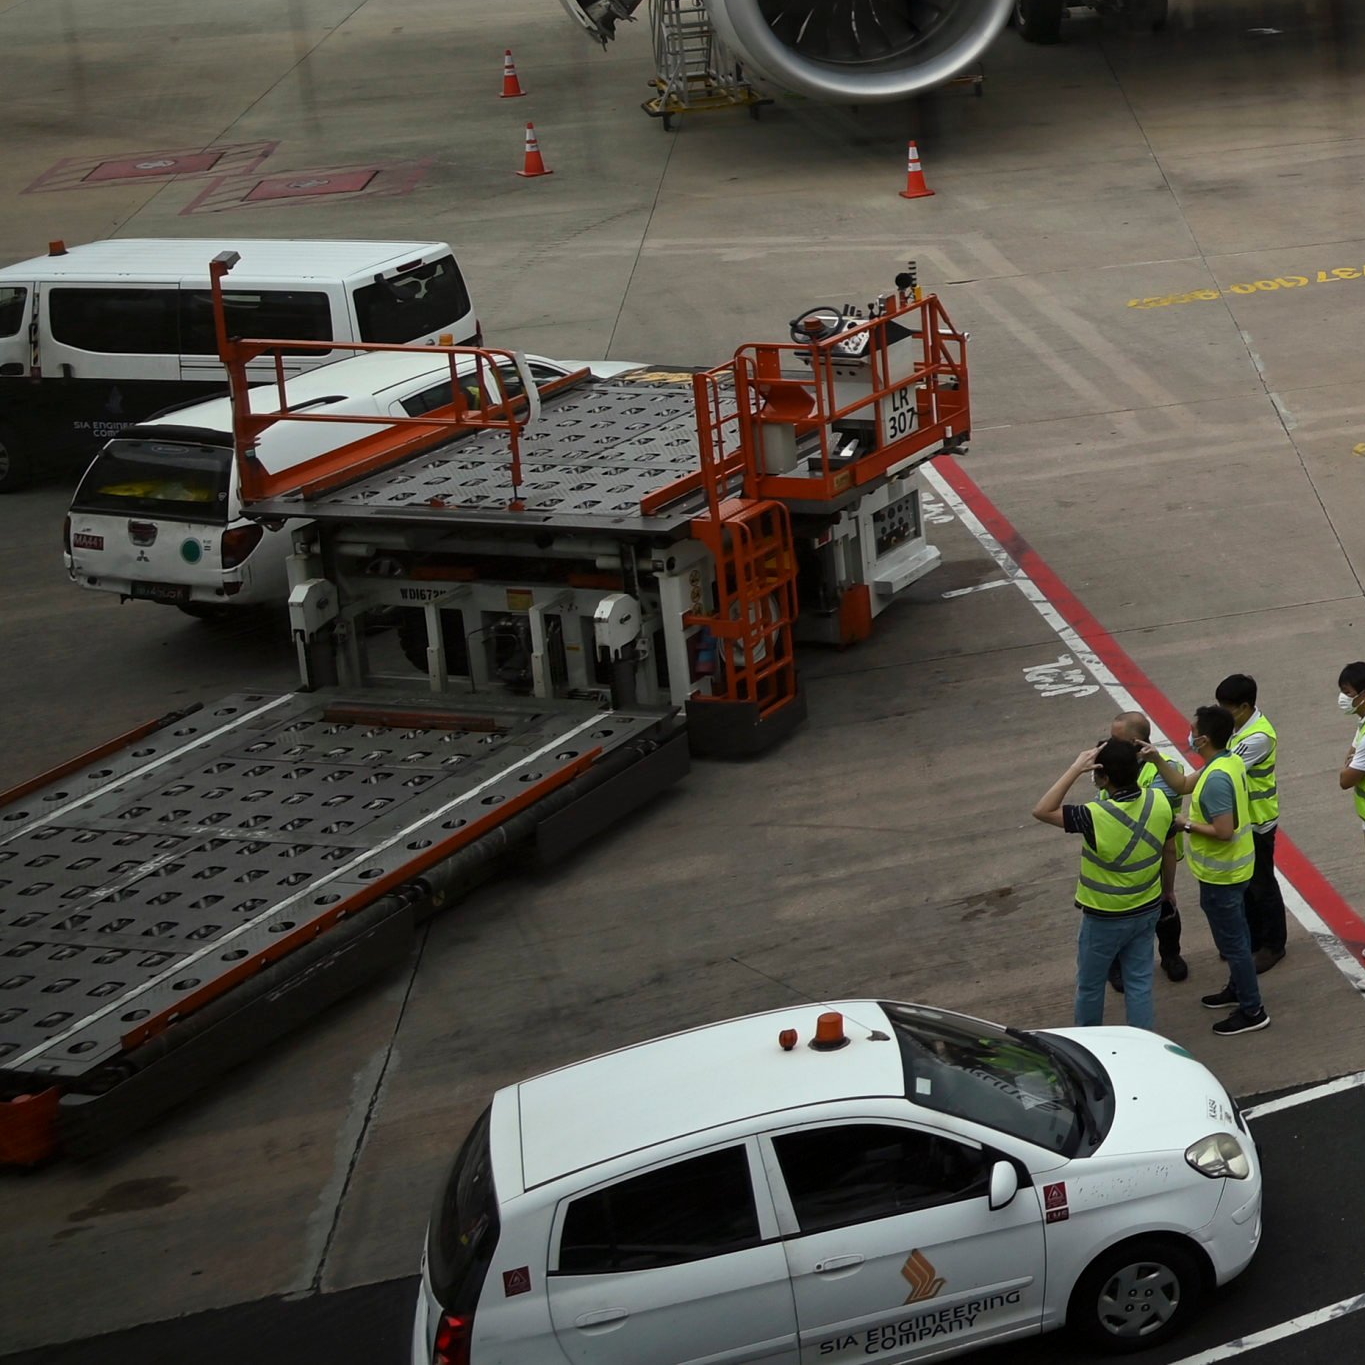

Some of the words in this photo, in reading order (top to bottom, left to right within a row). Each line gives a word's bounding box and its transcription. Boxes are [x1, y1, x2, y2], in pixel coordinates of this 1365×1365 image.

[891, 388, 909, 412] LR
[73, 421, 91, 430] SIA
[888, 409, 916, 439] 307
[820, 1334, 858, 1355] SIA
[867, 1290, 1021, 1344] ENGINEERING
[864, 1314, 978, 1355] COMPANY
